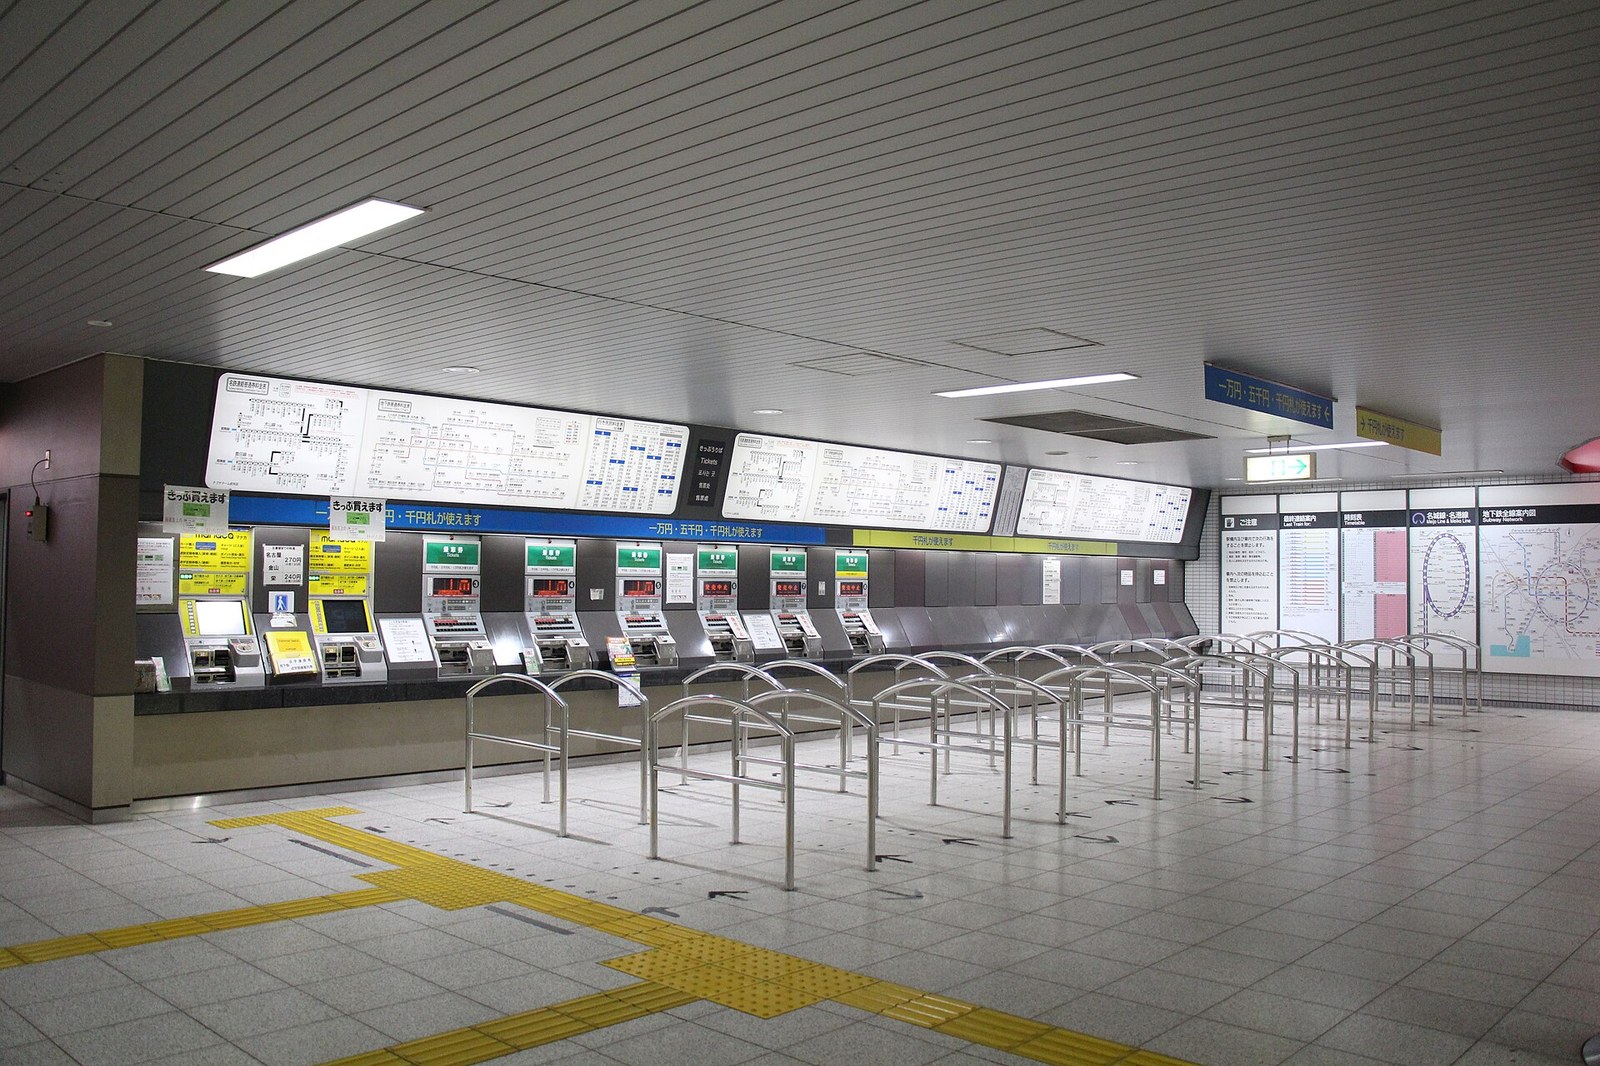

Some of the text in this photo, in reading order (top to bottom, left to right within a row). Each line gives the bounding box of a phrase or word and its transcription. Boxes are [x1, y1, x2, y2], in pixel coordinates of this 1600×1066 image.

[1218, 378, 1323, 420] 一万円・五千円・千円札が使えます
[700, 456, 718, 466] Tickets
[1239, 518, 1258, 527] ご注意
[648, 522, 763, 538] 一万円・五千円・千円札が使えます
[912, 535, 954, 547] 千円札が使えます
